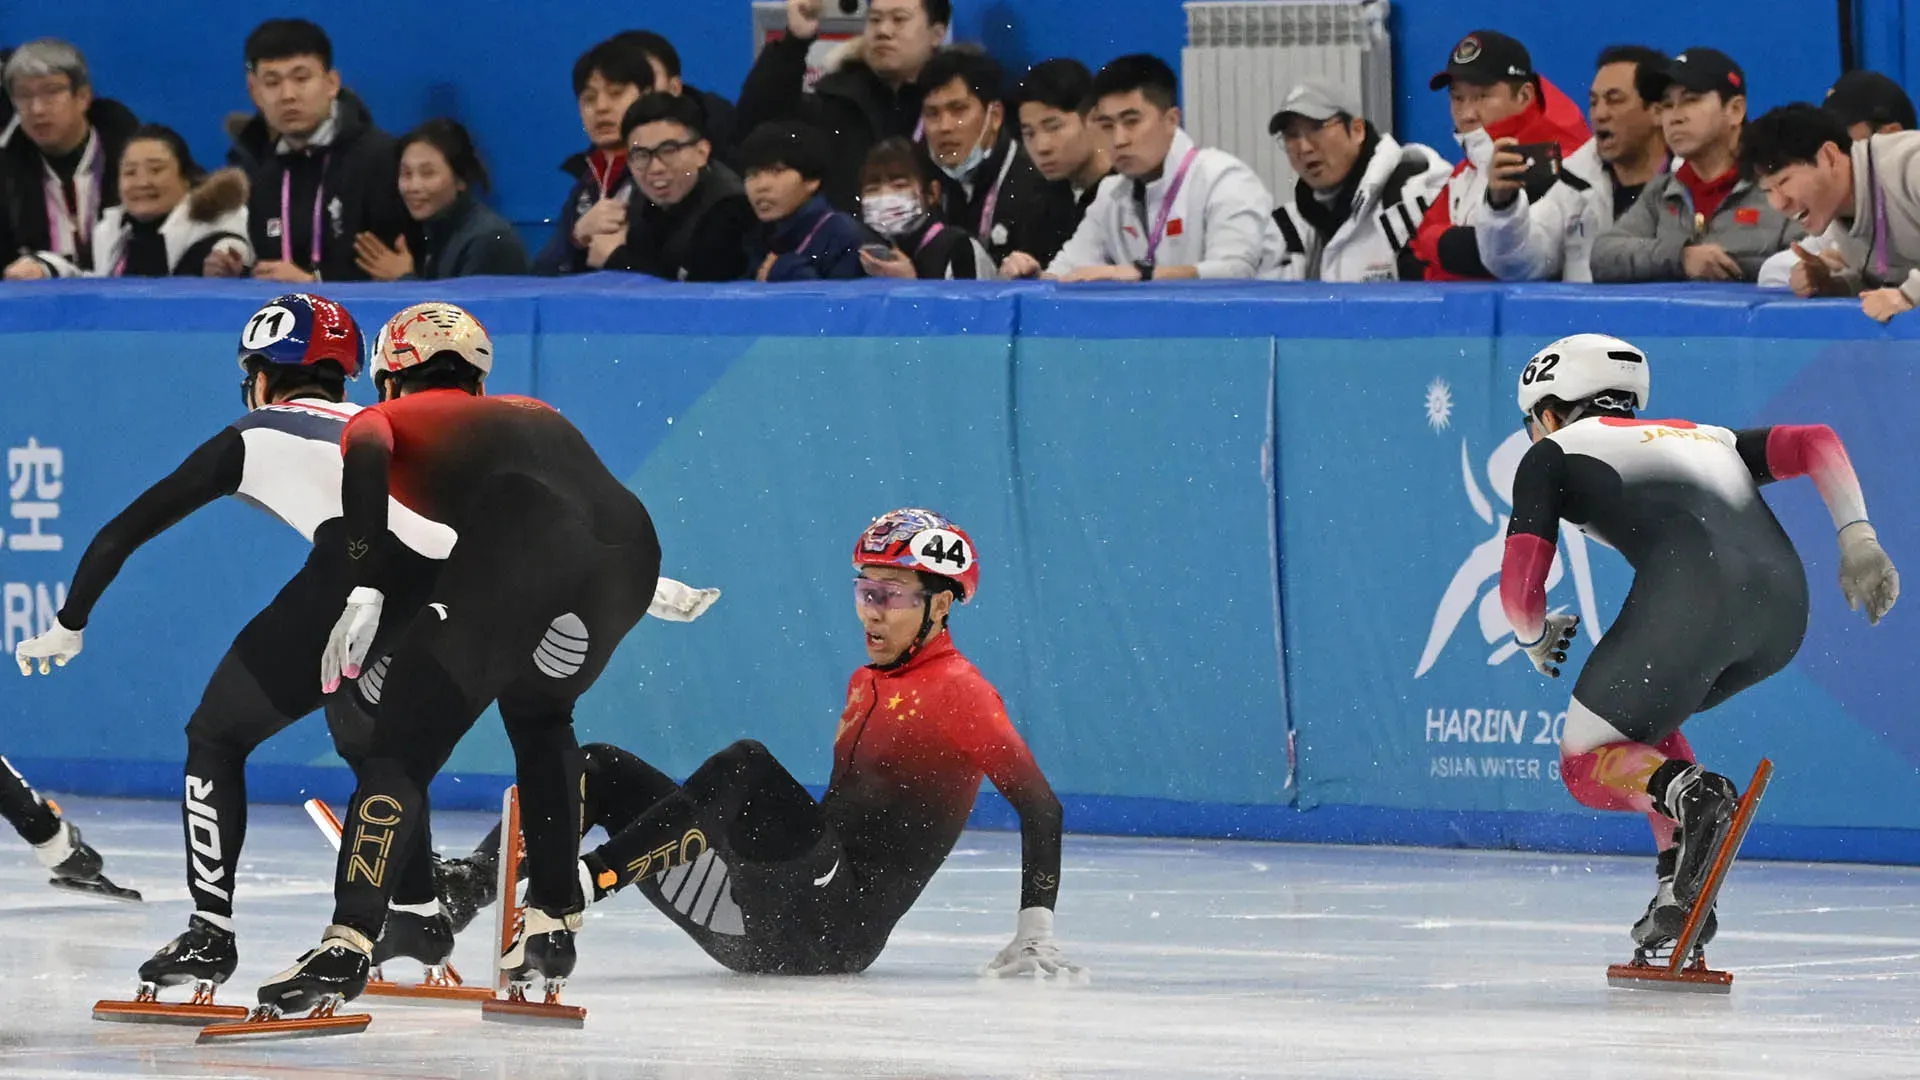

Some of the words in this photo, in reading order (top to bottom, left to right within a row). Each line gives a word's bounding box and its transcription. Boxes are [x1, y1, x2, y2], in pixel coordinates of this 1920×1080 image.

[249, 312, 284, 343] 71
[1522, 353, 1560, 386] 62
[0, 437, 64, 551] 空
[921, 534, 966, 569] 44
[185, 774, 230, 902] KOR
[347, 794, 403, 888] CHN
